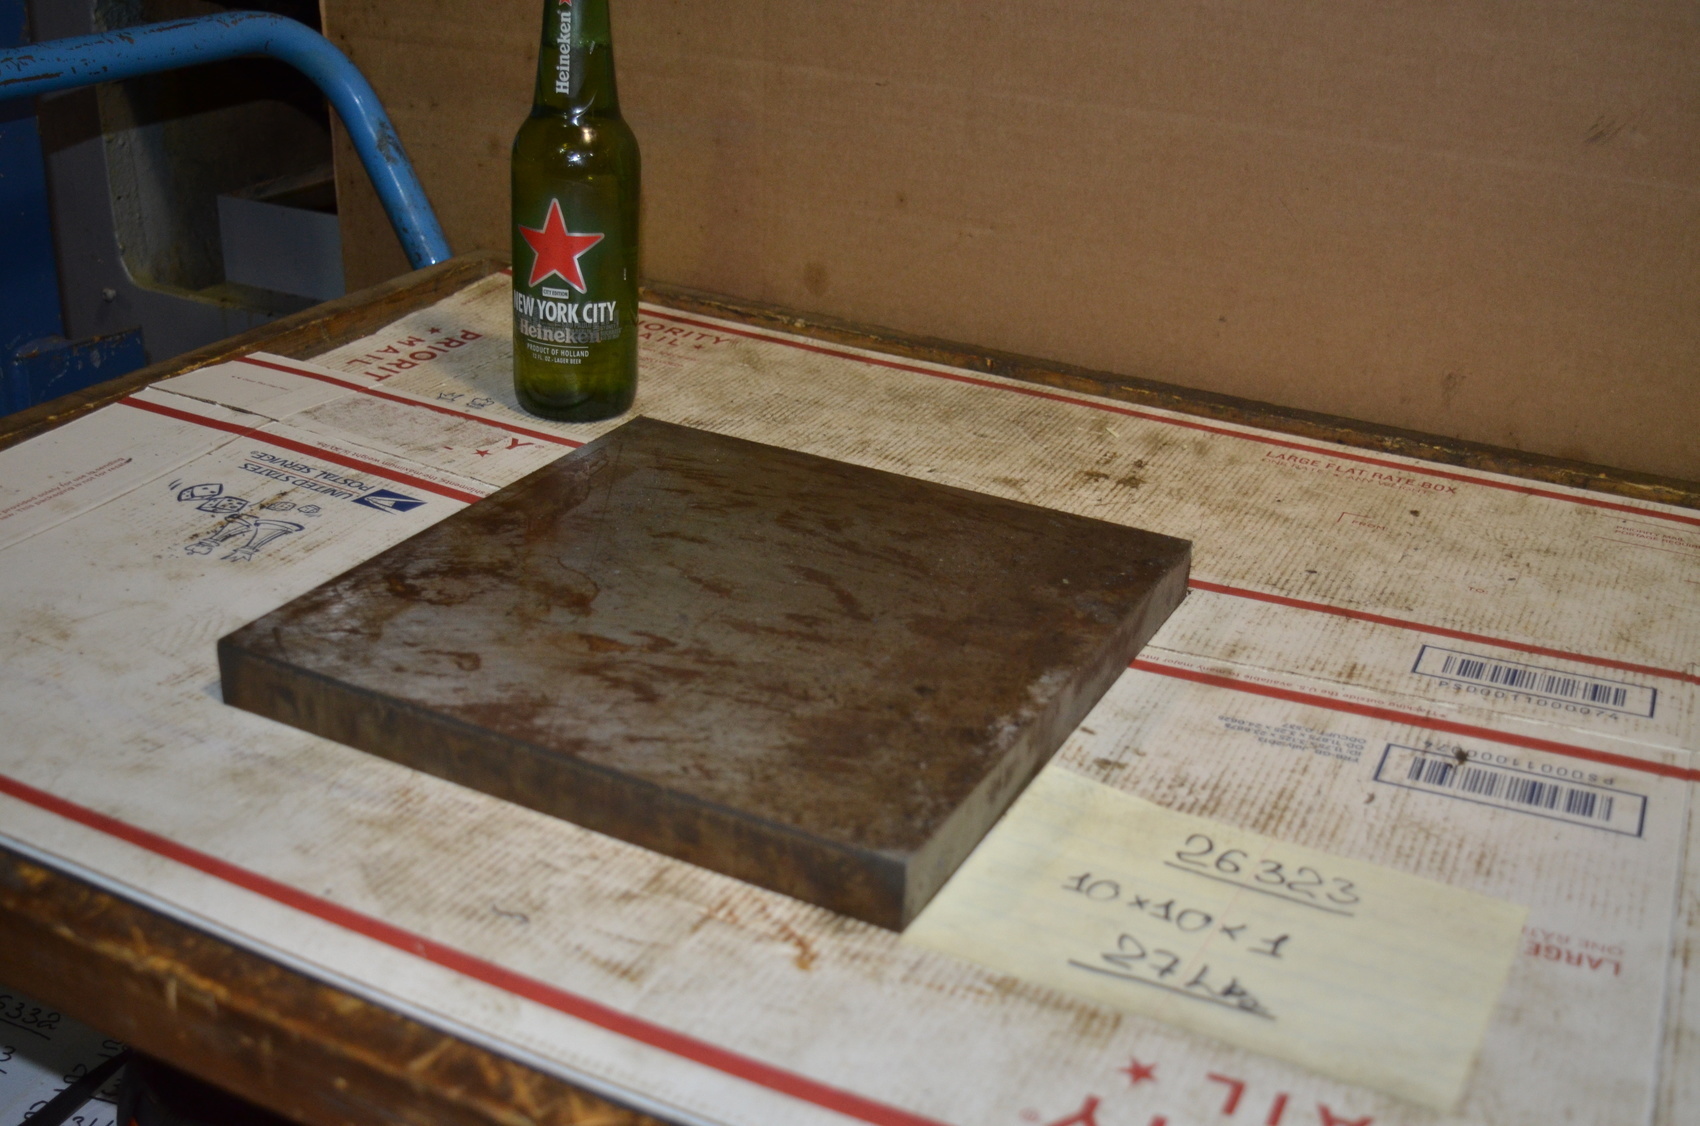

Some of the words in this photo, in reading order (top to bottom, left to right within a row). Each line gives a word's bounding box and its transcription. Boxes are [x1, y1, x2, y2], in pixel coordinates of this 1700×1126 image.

[556, 11, 572, 95] Heineken
[514, 290, 535, 317] NEW
[537, 299, 579, 323] YORK
[583, 301, 616, 323] CITY
[520, 318, 602, 344] Heineken
[639, 332, 679, 347] AIL
[347, 335, 426, 366] MAIL
[364, 329, 483, 382] PRIORIT
[527, 343, 550, 355] PRODUCT
[239, 463, 296, 482] STATES
[313, 470, 375, 492] POSTAL
[1265, 451, 1321, 466] LARGE
[1325, 463, 1367, 476] FLAT
[1372, 472, 1416, 485] RATE
[1421, 481, 1457, 494] BOX
[292, 479, 354, 500] UNITED
[1351, 519, 1388, 531] FROM:
[1244, 674, 1293, 687] available
[1176, 833, 1360, 905] 26323
[1523, 940, 1623, 977] LARGE
